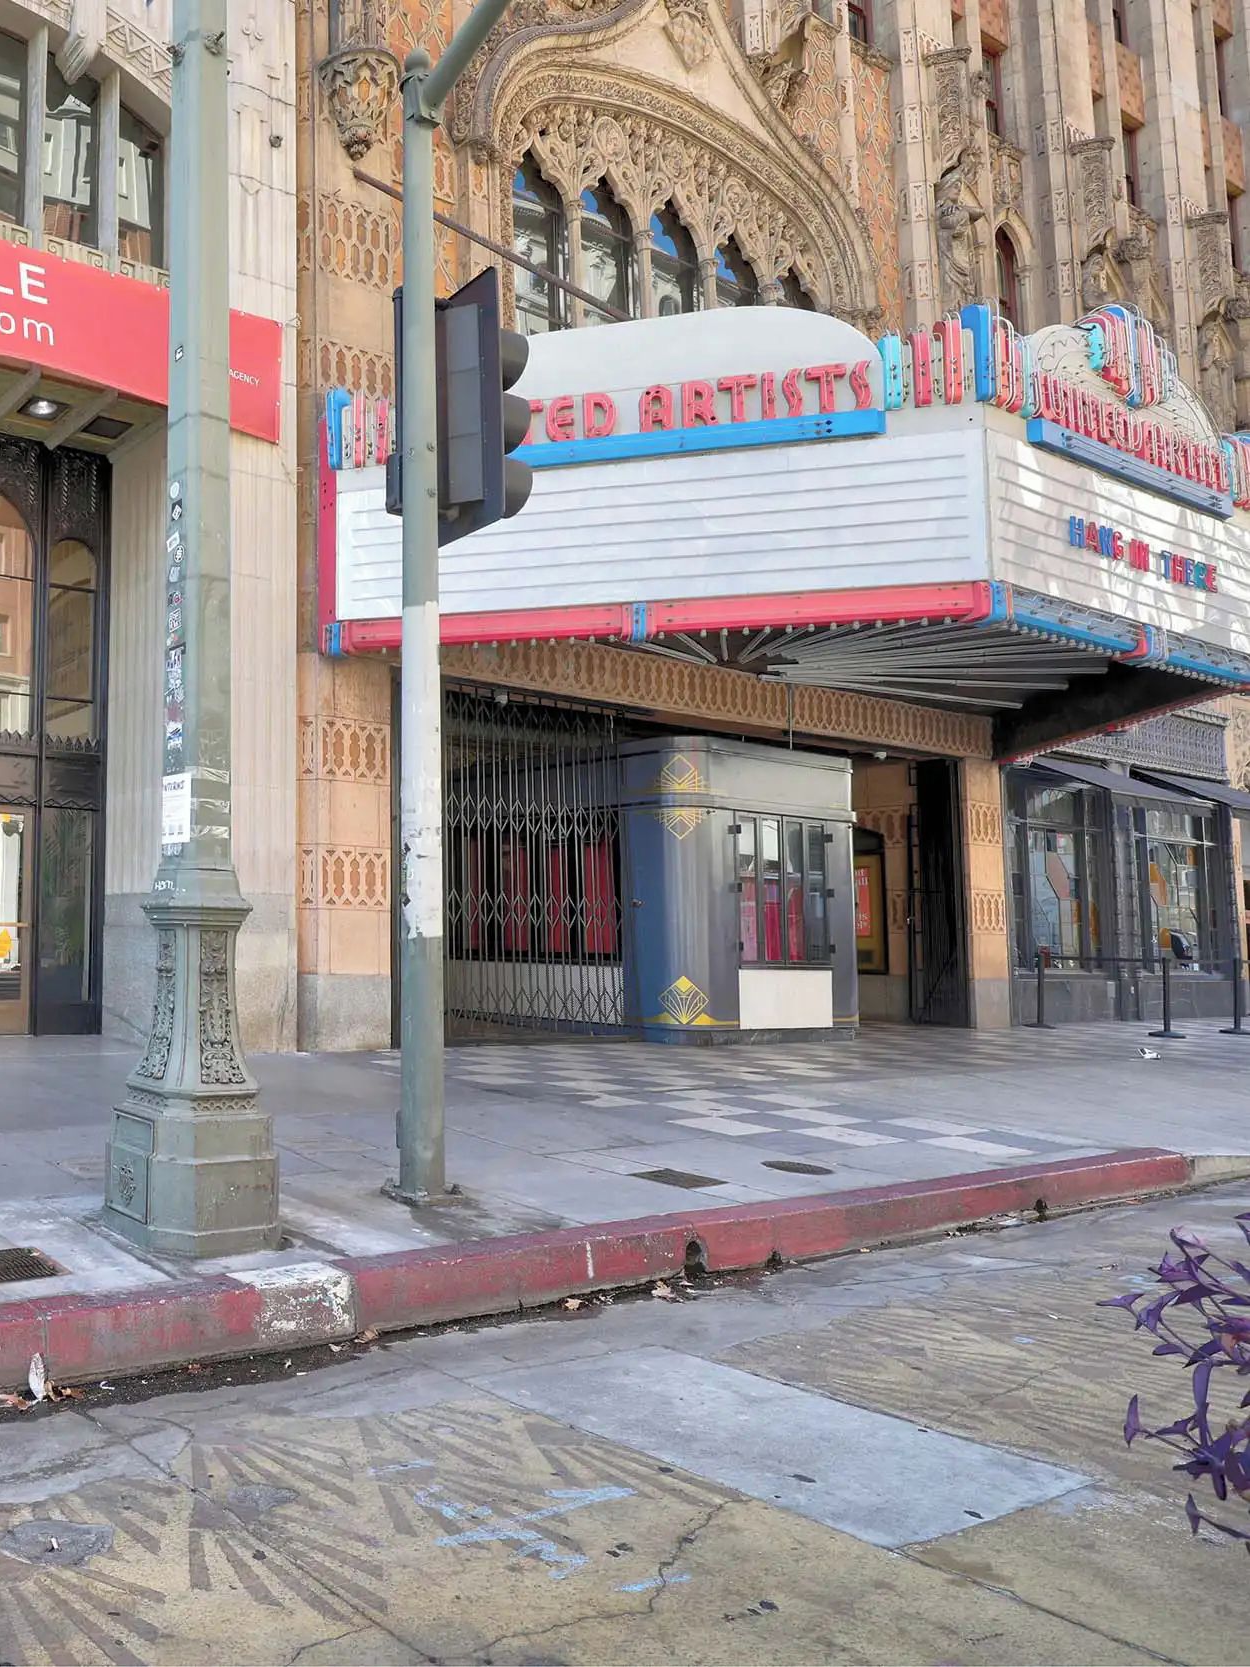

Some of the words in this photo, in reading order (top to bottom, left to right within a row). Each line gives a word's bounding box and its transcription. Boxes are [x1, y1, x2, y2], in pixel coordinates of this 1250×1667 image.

[229, 369, 261, 387] AGENCY
[639, 361, 872, 433] ARTISTS
[1069, 515, 1124, 562] HANG
[1128, 537, 1150, 573] IN
[1160, 549, 1218, 594] THERE
